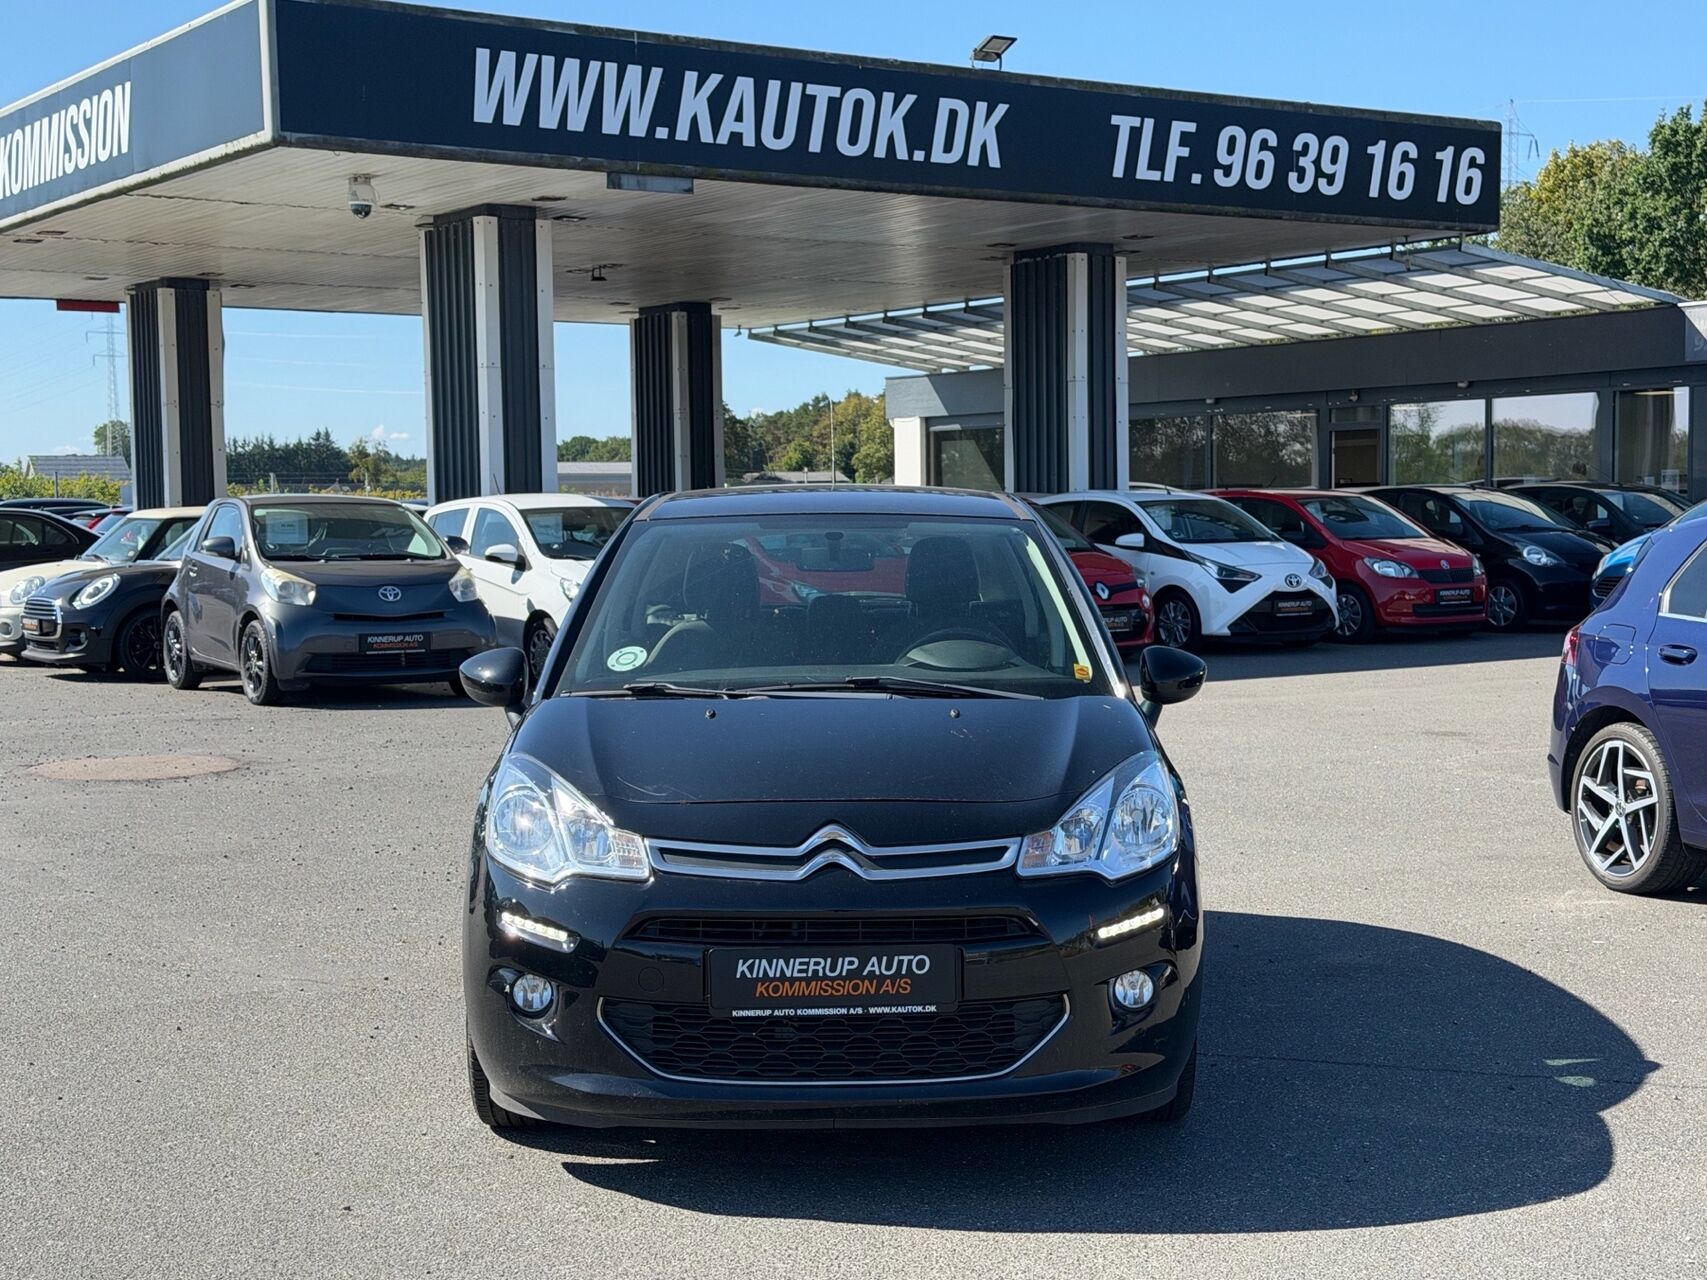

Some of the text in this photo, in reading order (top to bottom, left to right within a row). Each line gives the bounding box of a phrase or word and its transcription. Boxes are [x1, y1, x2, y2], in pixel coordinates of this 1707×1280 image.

[472, 47, 1010, 169] WWW.KAUTOK.DK
[0, 81, 131, 200] KOMMISSION
[1110, 114, 1485, 205] TLF. 96 39 16 16
[367, 634, 424, 643] KINNERUP AUTO
[736, 954, 931, 979] KINNERUP AUTO
[755, 977, 912, 998] KOMMISSION A/S
[732, 1005, 937, 1018] KINNERUP AUTO KOMMISSION A/S WWW.KAUTOK.DK
